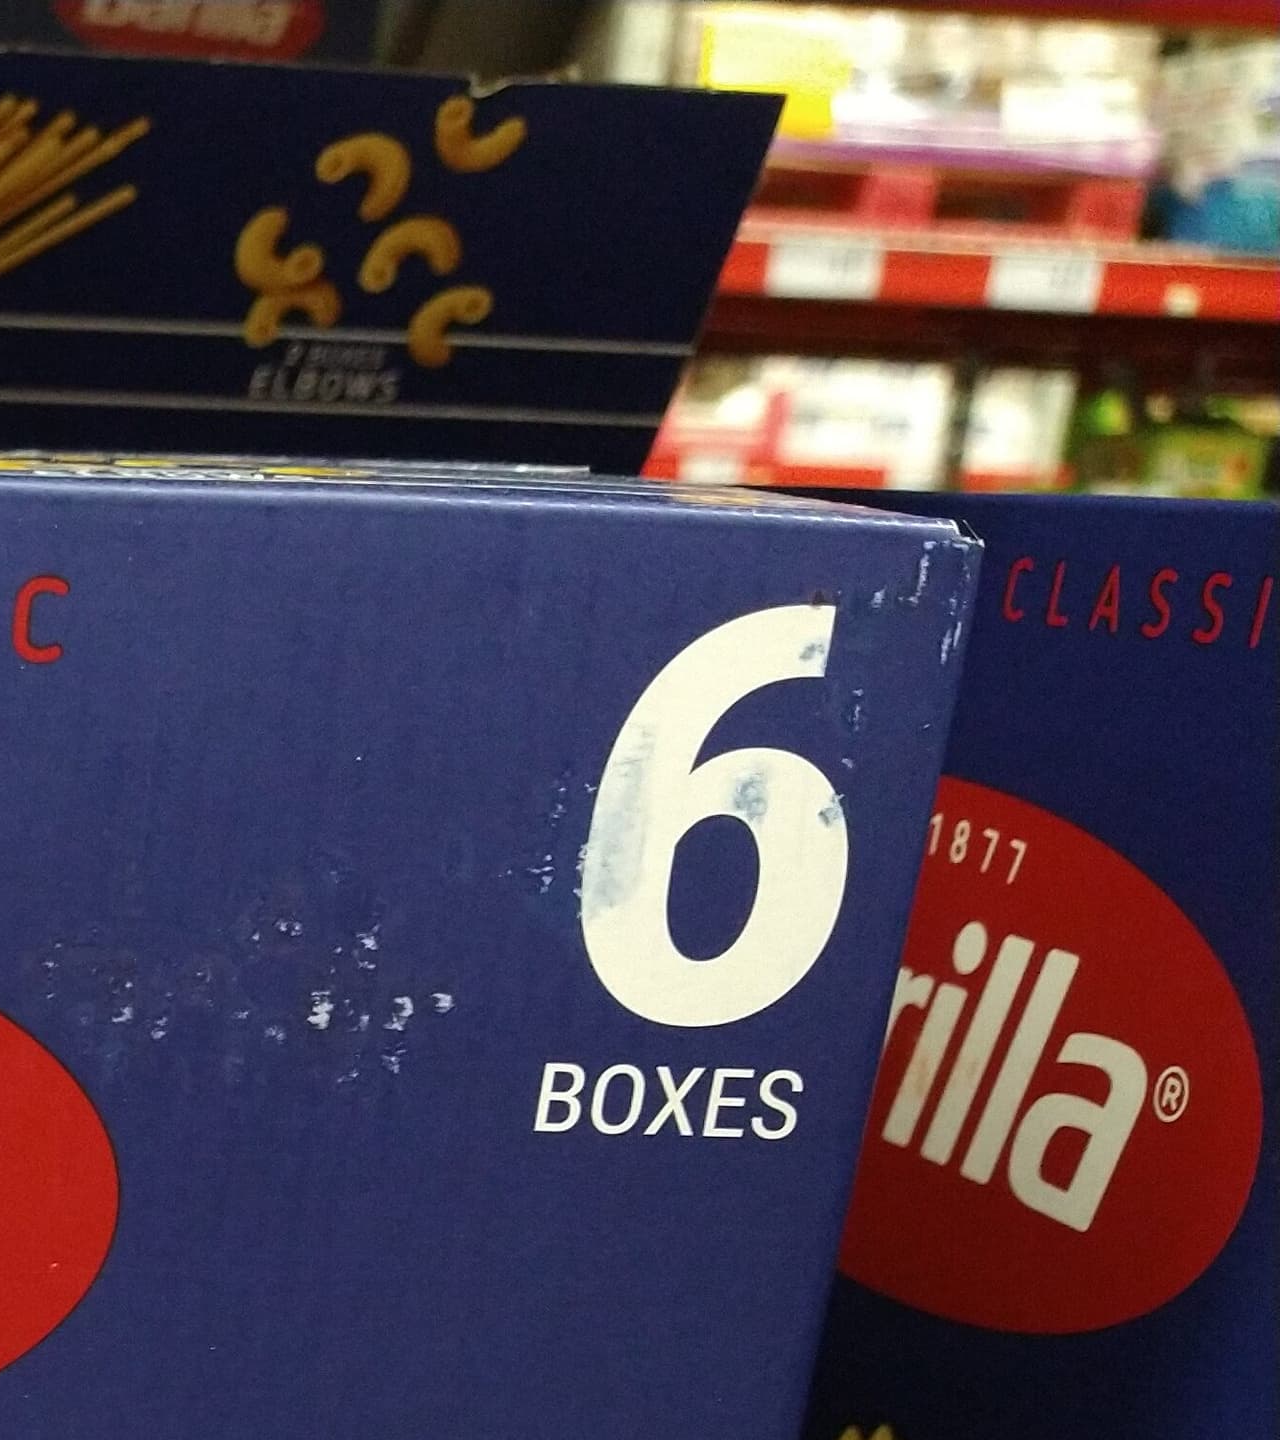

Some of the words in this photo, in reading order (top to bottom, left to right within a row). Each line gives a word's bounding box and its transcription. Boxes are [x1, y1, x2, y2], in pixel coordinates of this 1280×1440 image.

[582, 604, 848, 1028] 6
[929, 813, 1028, 885] 1877
[533, 1062, 804, 1140] BOXES
